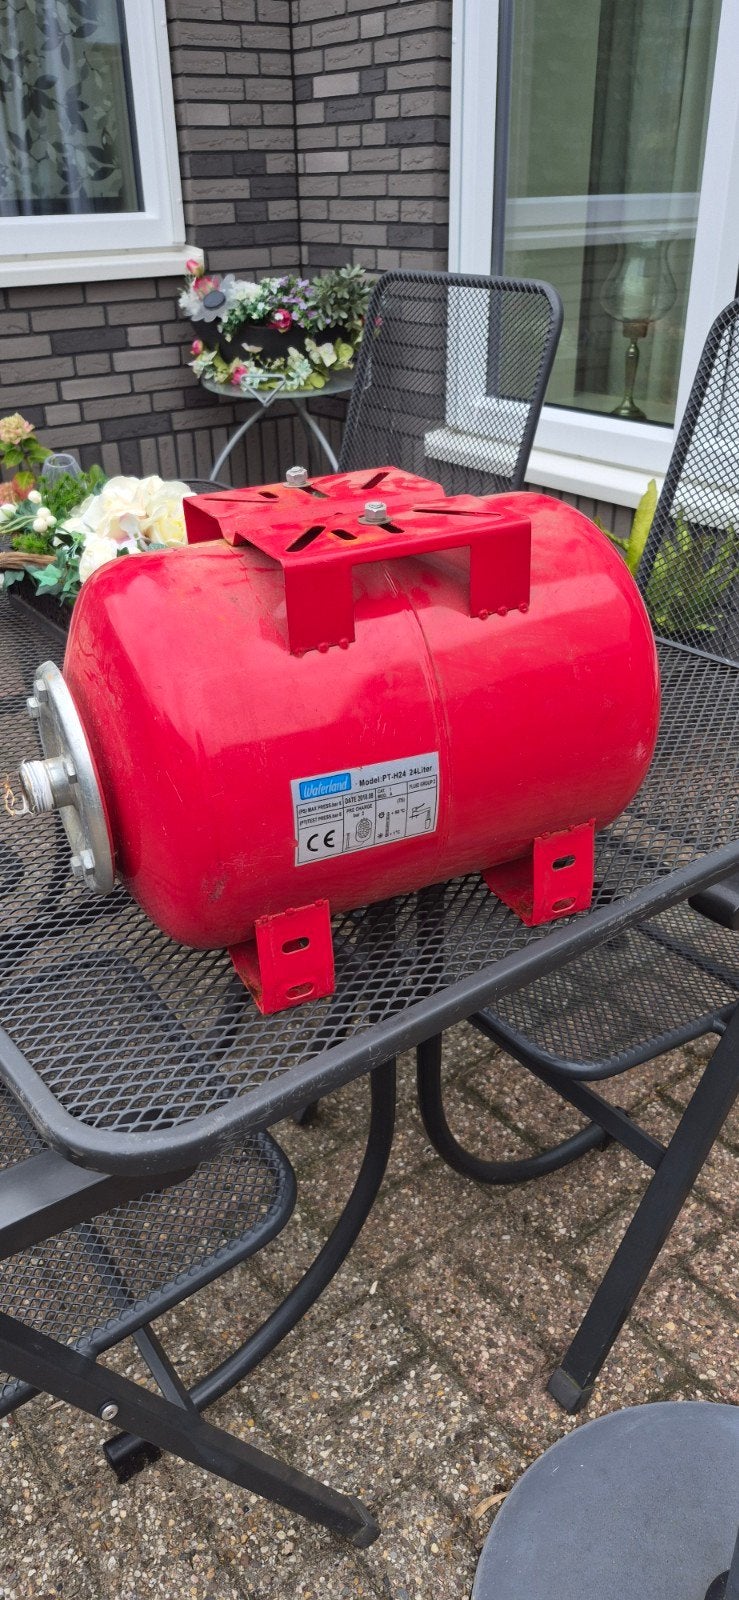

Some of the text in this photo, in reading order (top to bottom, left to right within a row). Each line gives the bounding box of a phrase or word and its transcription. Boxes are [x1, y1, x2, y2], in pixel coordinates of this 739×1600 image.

[409, 766, 432, 776] 24Liter
[303, 776, 348, 798] Waterland
[345, 796, 356, 804] DATE
[306, 829, 335, 852] CE
